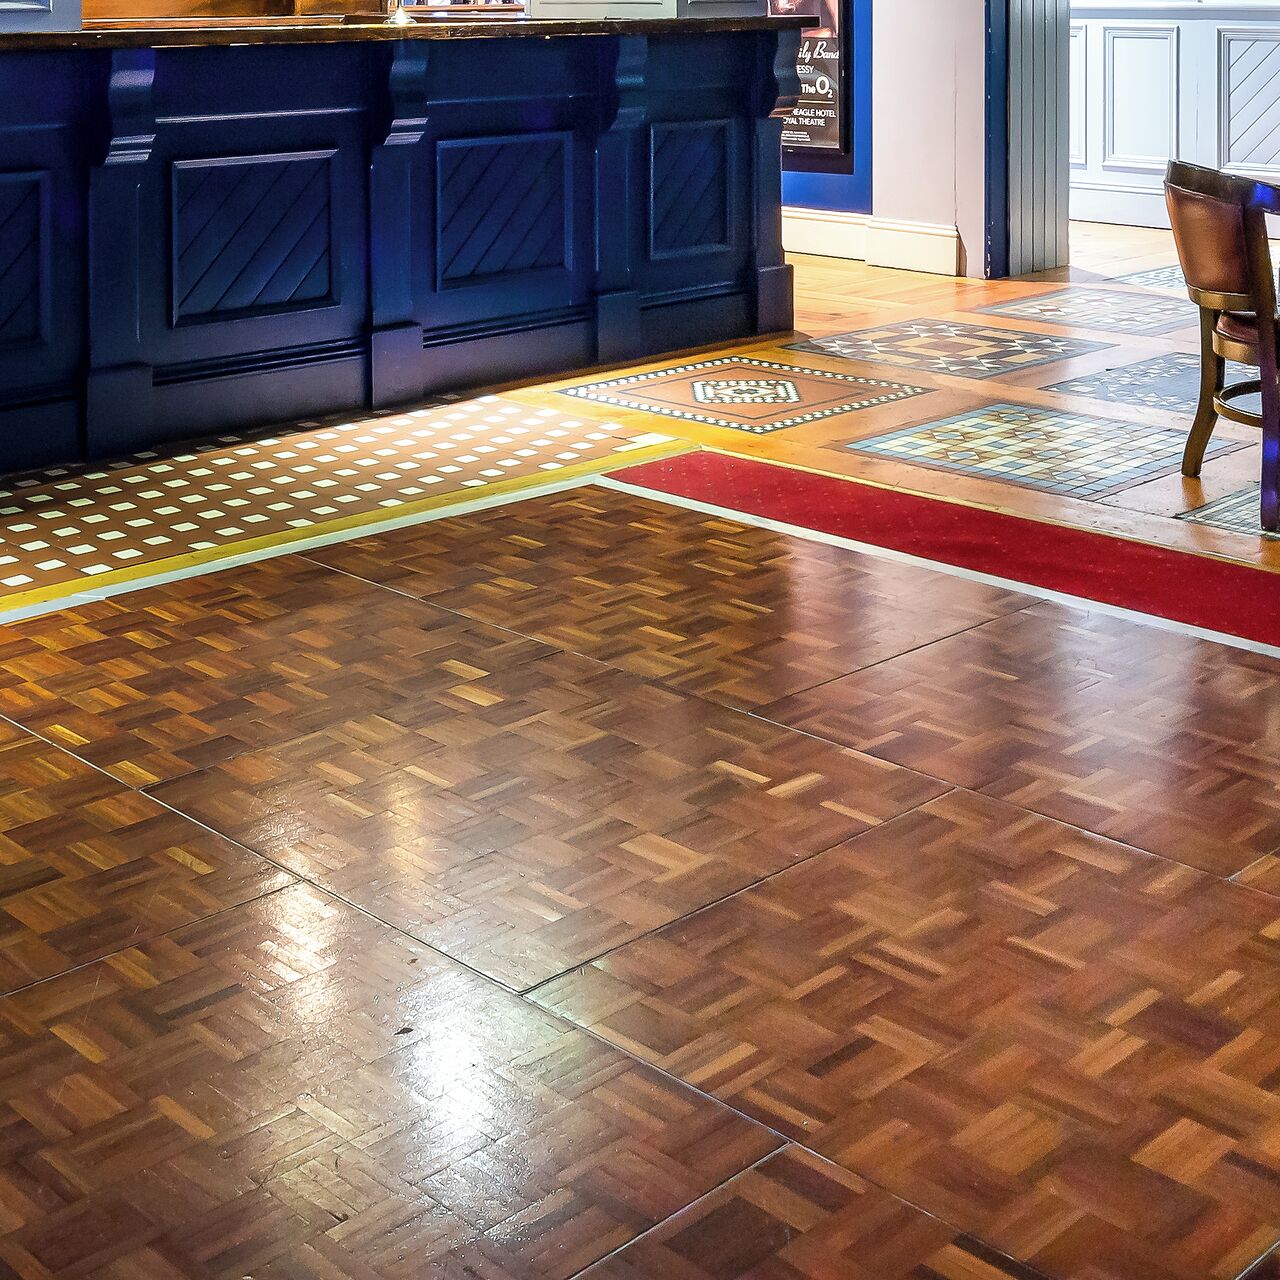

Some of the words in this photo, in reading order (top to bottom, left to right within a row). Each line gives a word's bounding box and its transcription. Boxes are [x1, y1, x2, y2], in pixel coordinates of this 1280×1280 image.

[813, 41, 839, 59] Band
[801, 83, 816, 94] The
[815, 109, 837, 118] HOTEL
[799, 117, 826, 127] THEATRE
